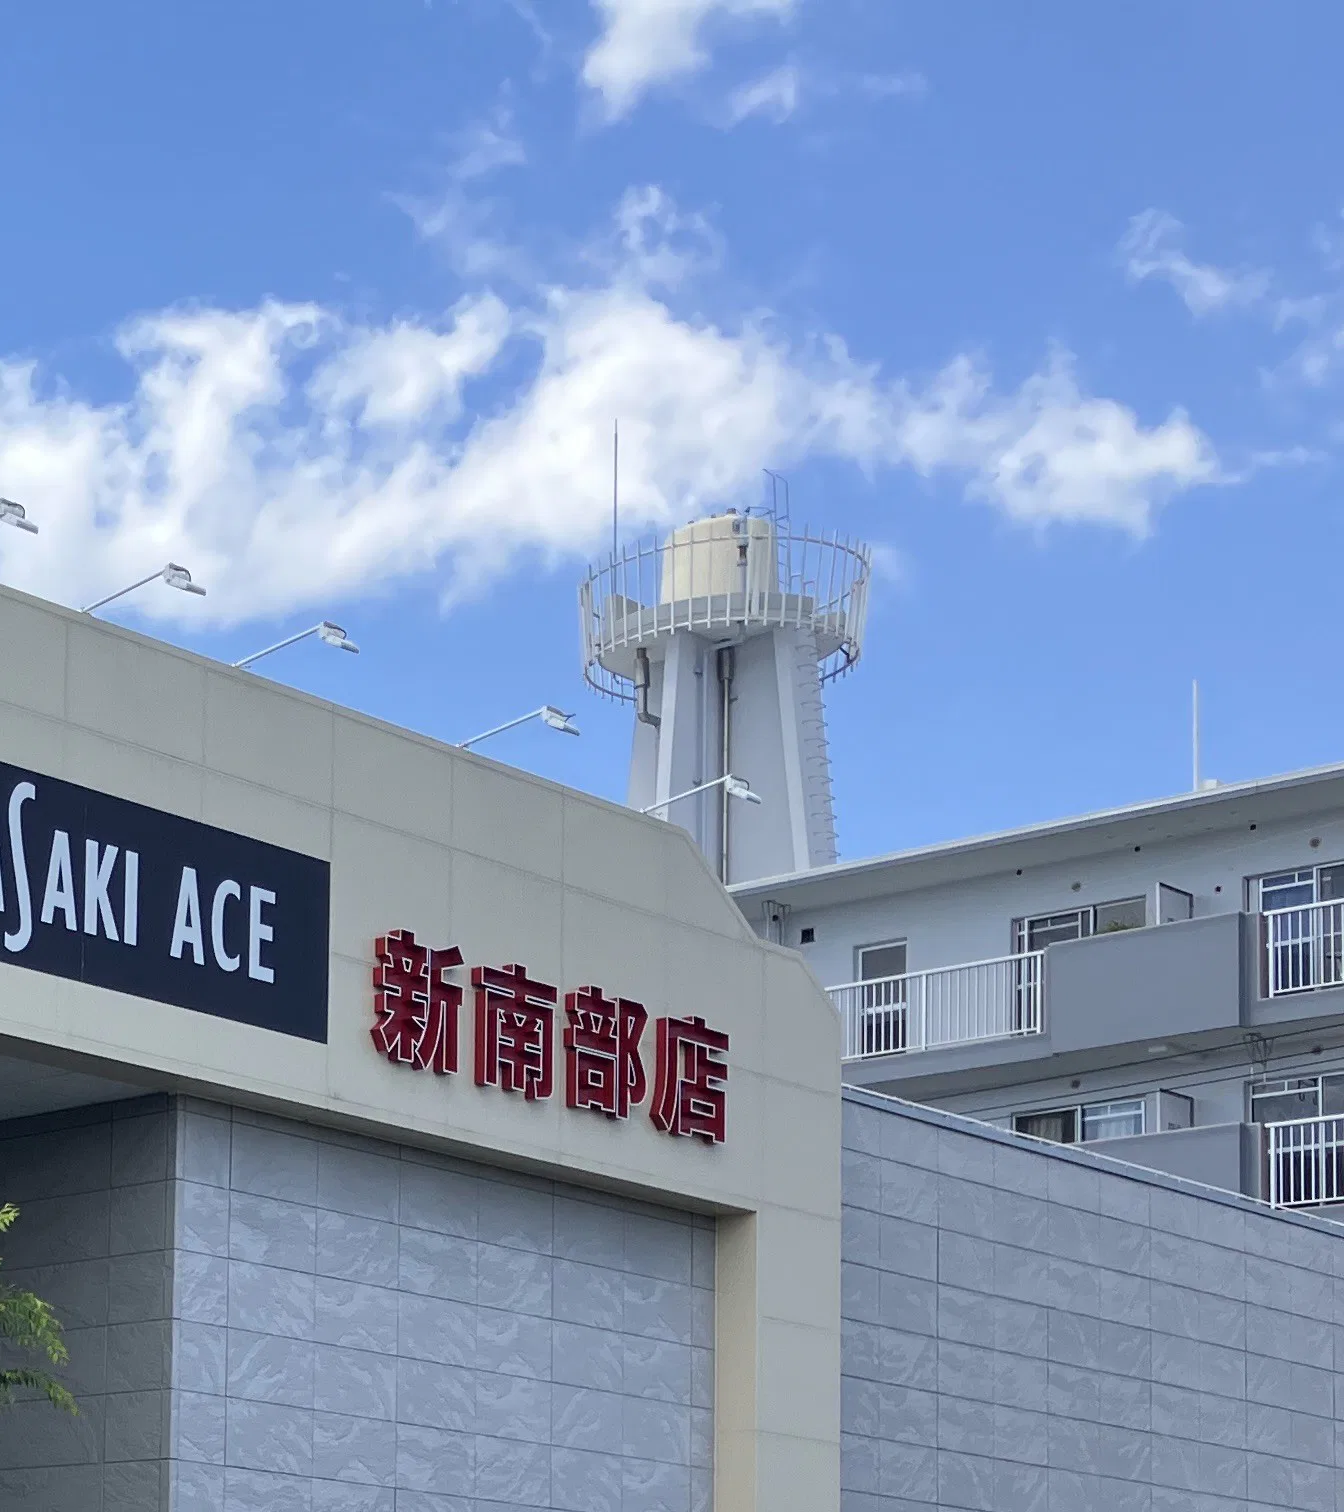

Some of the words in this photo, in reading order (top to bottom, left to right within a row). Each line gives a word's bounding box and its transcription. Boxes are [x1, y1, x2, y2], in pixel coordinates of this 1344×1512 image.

[169, 865, 277, 984] ACE
[369, 928, 730, 1144] 新南部店
